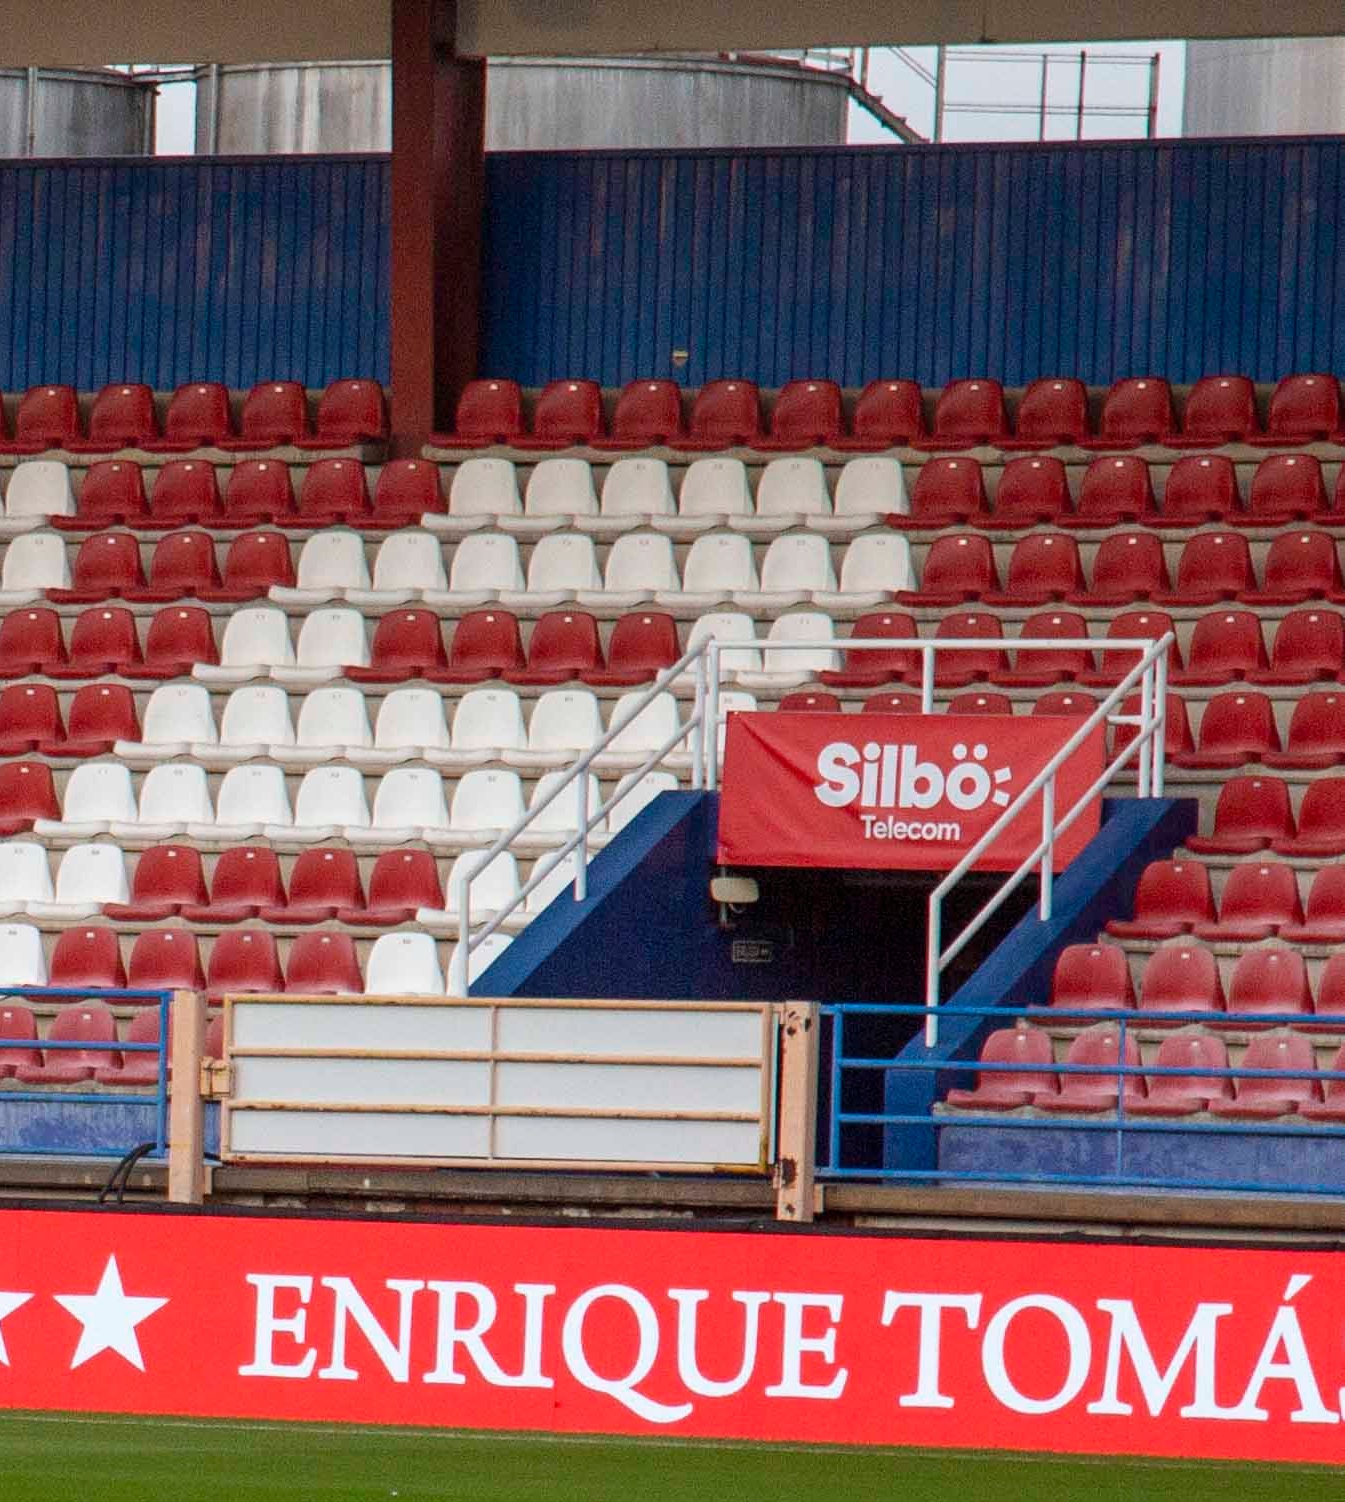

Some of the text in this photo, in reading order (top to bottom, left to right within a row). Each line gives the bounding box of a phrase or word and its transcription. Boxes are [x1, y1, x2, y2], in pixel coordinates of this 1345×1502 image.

[861, 816, 960, 841] Telecom
[237, 1272, 1345, 1424] ENRIQUE TOMÁ
